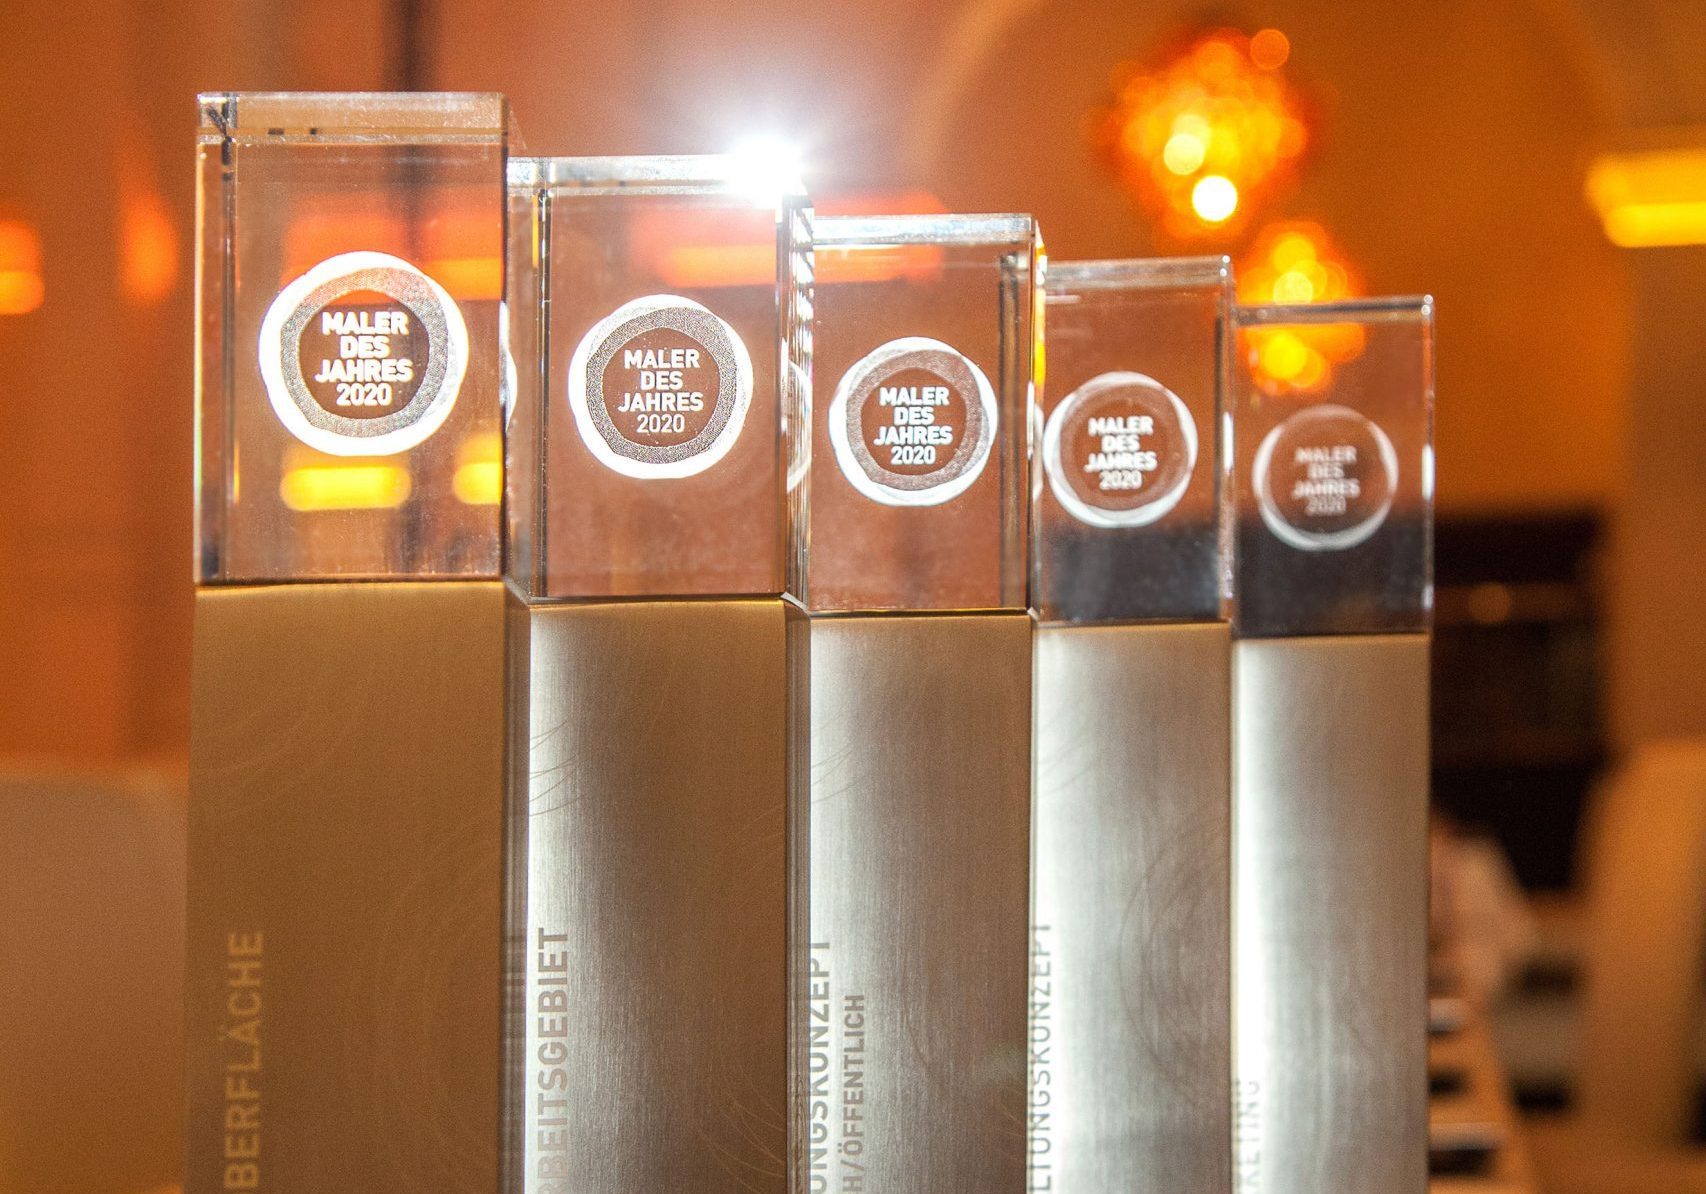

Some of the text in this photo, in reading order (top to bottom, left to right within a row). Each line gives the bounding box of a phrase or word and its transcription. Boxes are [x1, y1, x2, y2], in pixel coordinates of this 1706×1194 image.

[322, 311, 409, 335] MALER
[340, 335, 391, 359] DES
[624, 348, 700, 369] MALER
[315, 358, 414, 384] JAHRES
[640, 370, 684, 391] DES
[336, 382, 393, 406] 2020
[617, 391, 704, 412] JAHRES
[879, 386, 950, 406] MALER
[636, 413, 685, 433] 2020
[894, 406, 935, 426] DES
[1088, 415, 1154, 437] MALER
[873, 425, 953, 446] JAHRES
[1101, 433, 1141, 453] DES
[890, 445, 936, 465] 2020
[1083, 450, 1158, 473] JAHRES
[1099, 469, 1142, 490] 2020
[219, 930, 264, 1190] BERFLÄCHE
